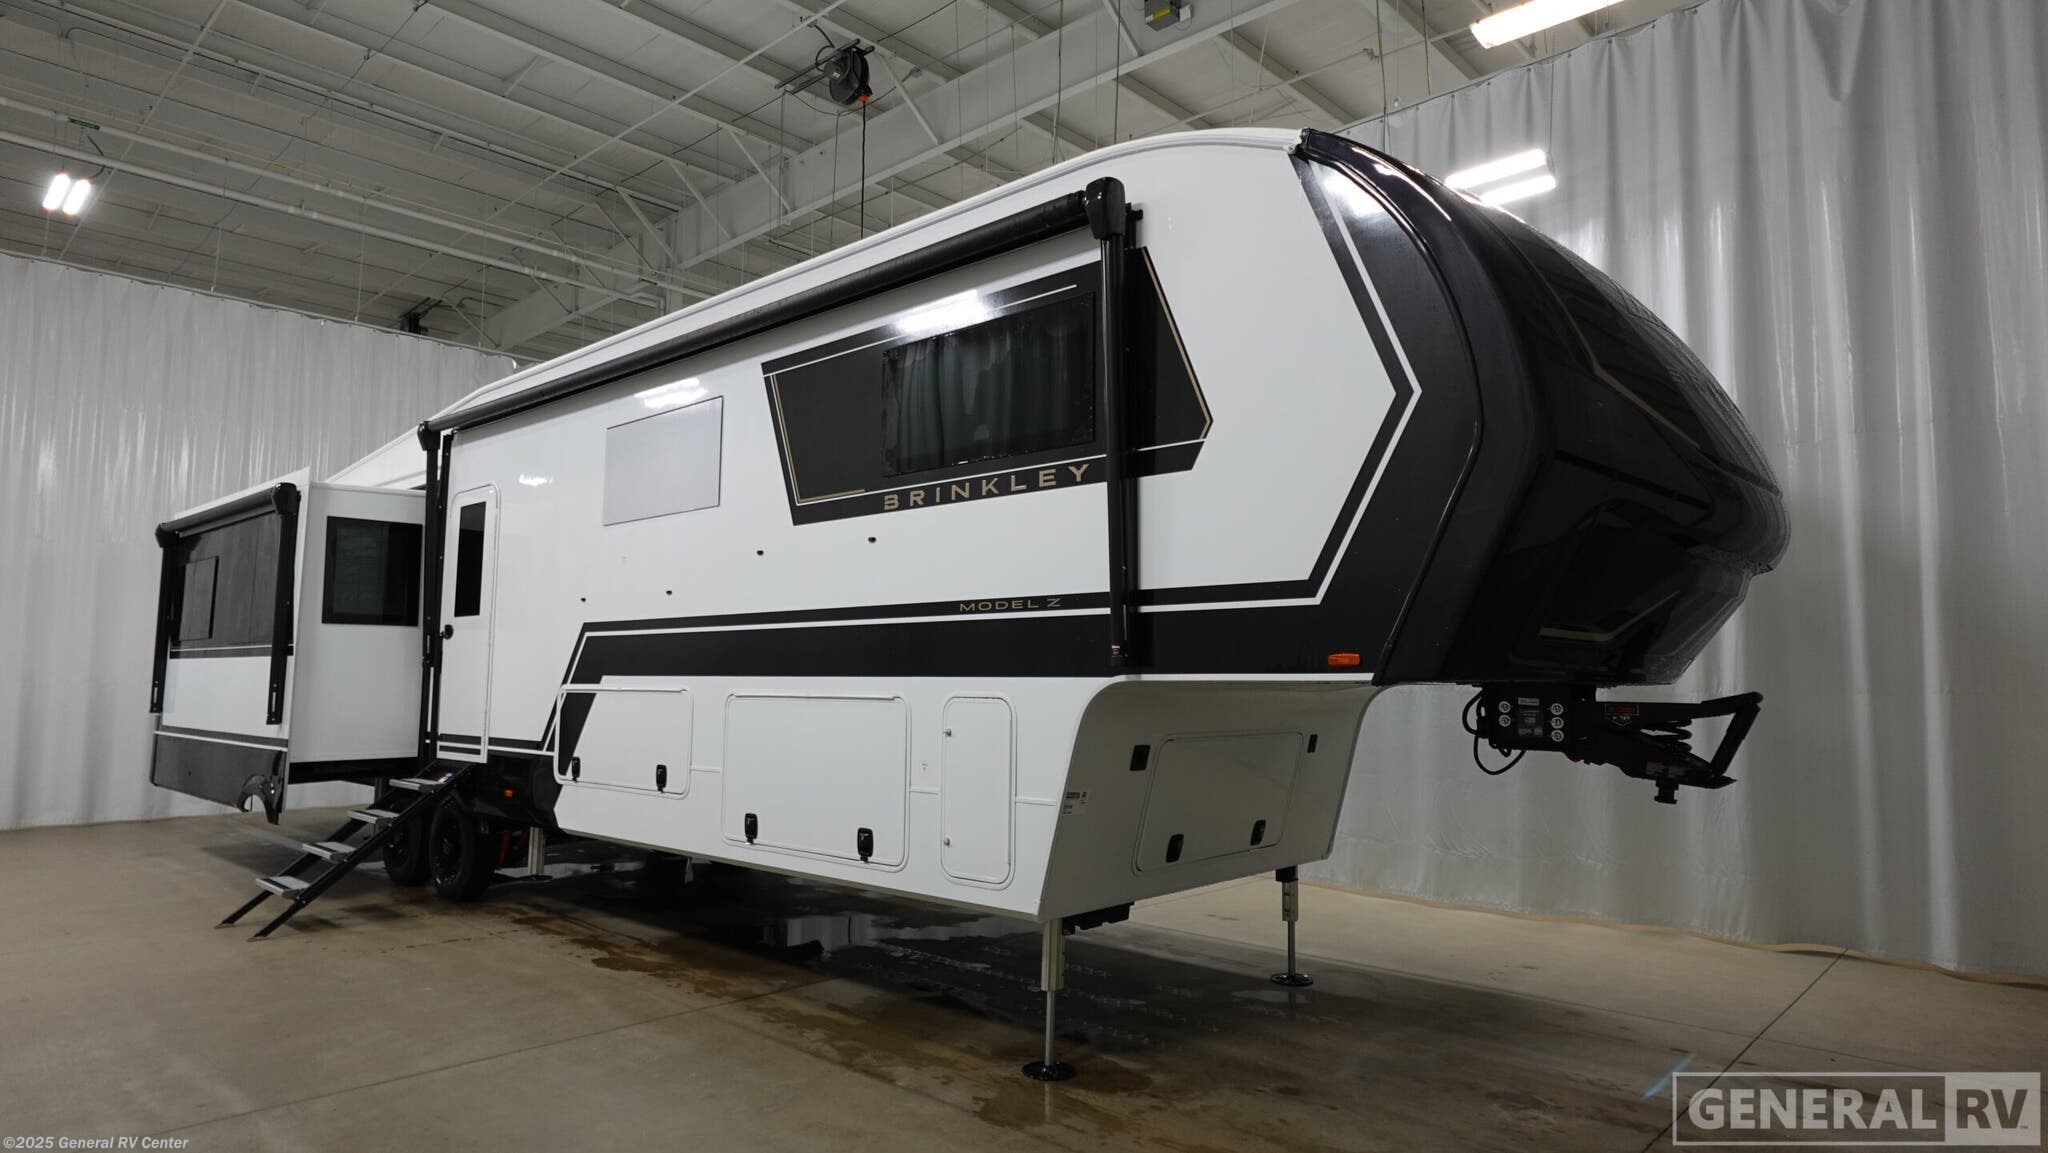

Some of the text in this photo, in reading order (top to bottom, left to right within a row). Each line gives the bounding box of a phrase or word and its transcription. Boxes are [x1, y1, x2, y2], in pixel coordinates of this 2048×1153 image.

[884, 463, 1089, 511] BRINKLEY
[959, 598, 1061, 612] MODEL Z
